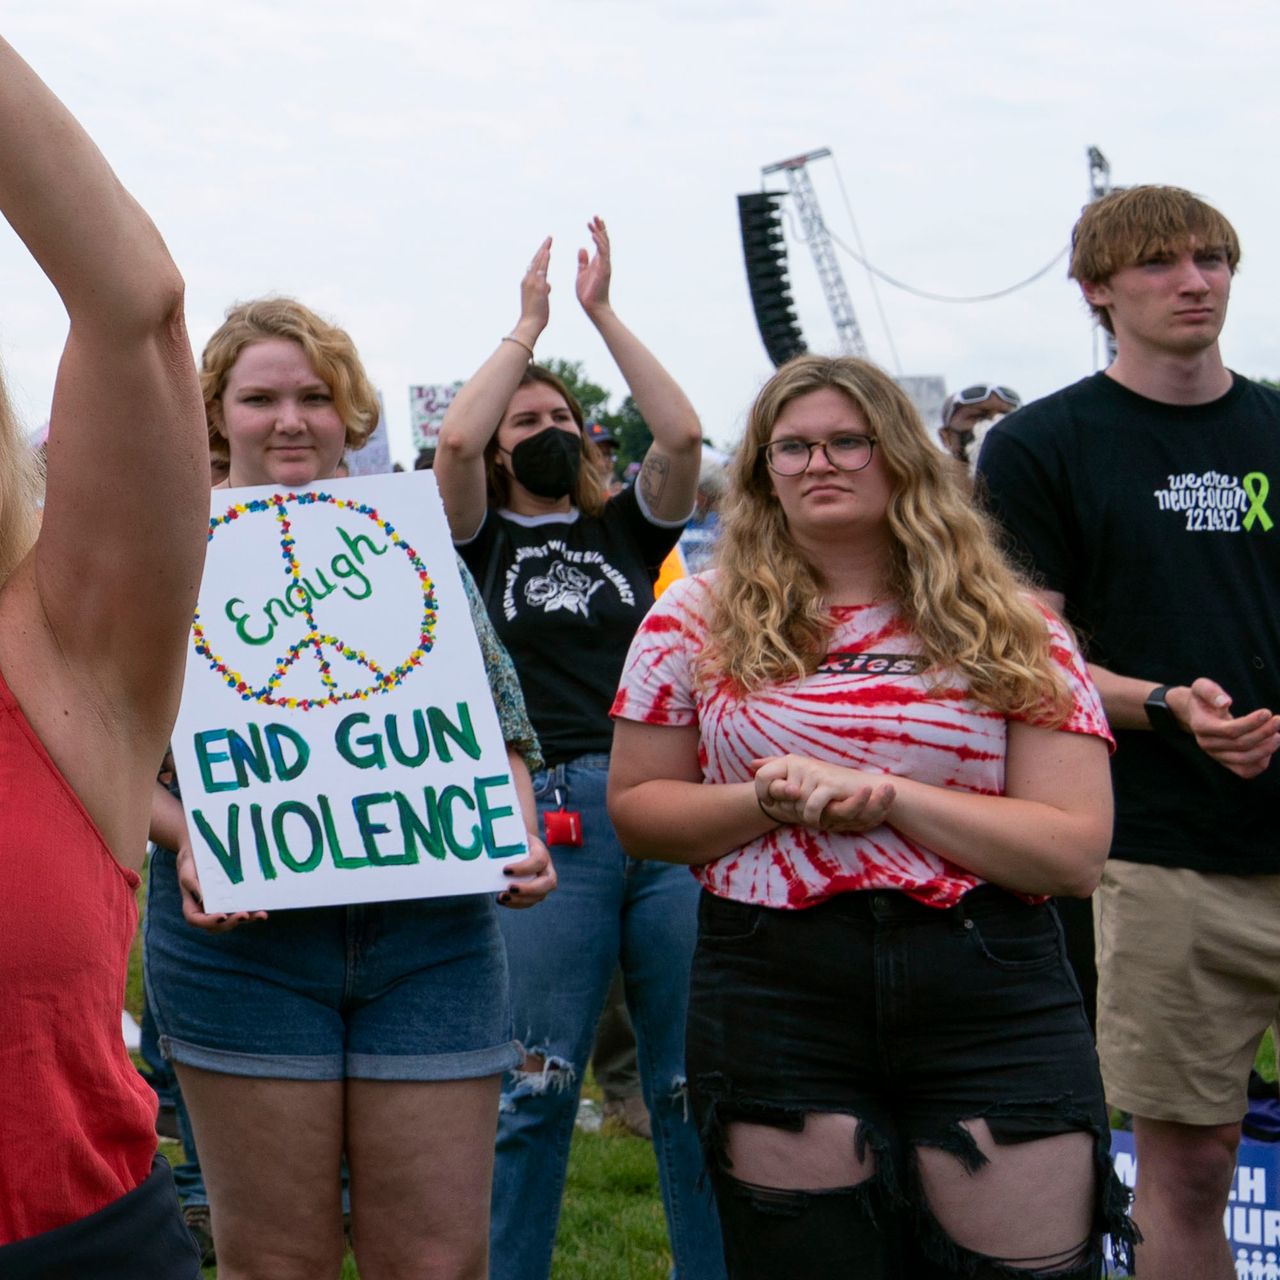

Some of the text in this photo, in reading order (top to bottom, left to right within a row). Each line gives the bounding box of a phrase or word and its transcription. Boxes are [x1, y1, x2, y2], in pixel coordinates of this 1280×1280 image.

[1153, 485, 1248, 513] newtown
[1167, 470, 1238, 490] we are
[225, 526, 389, 646] Enough
[194, 702, 482, 794] END GUN
[191, 774, 527, 885] VIOLENCE
